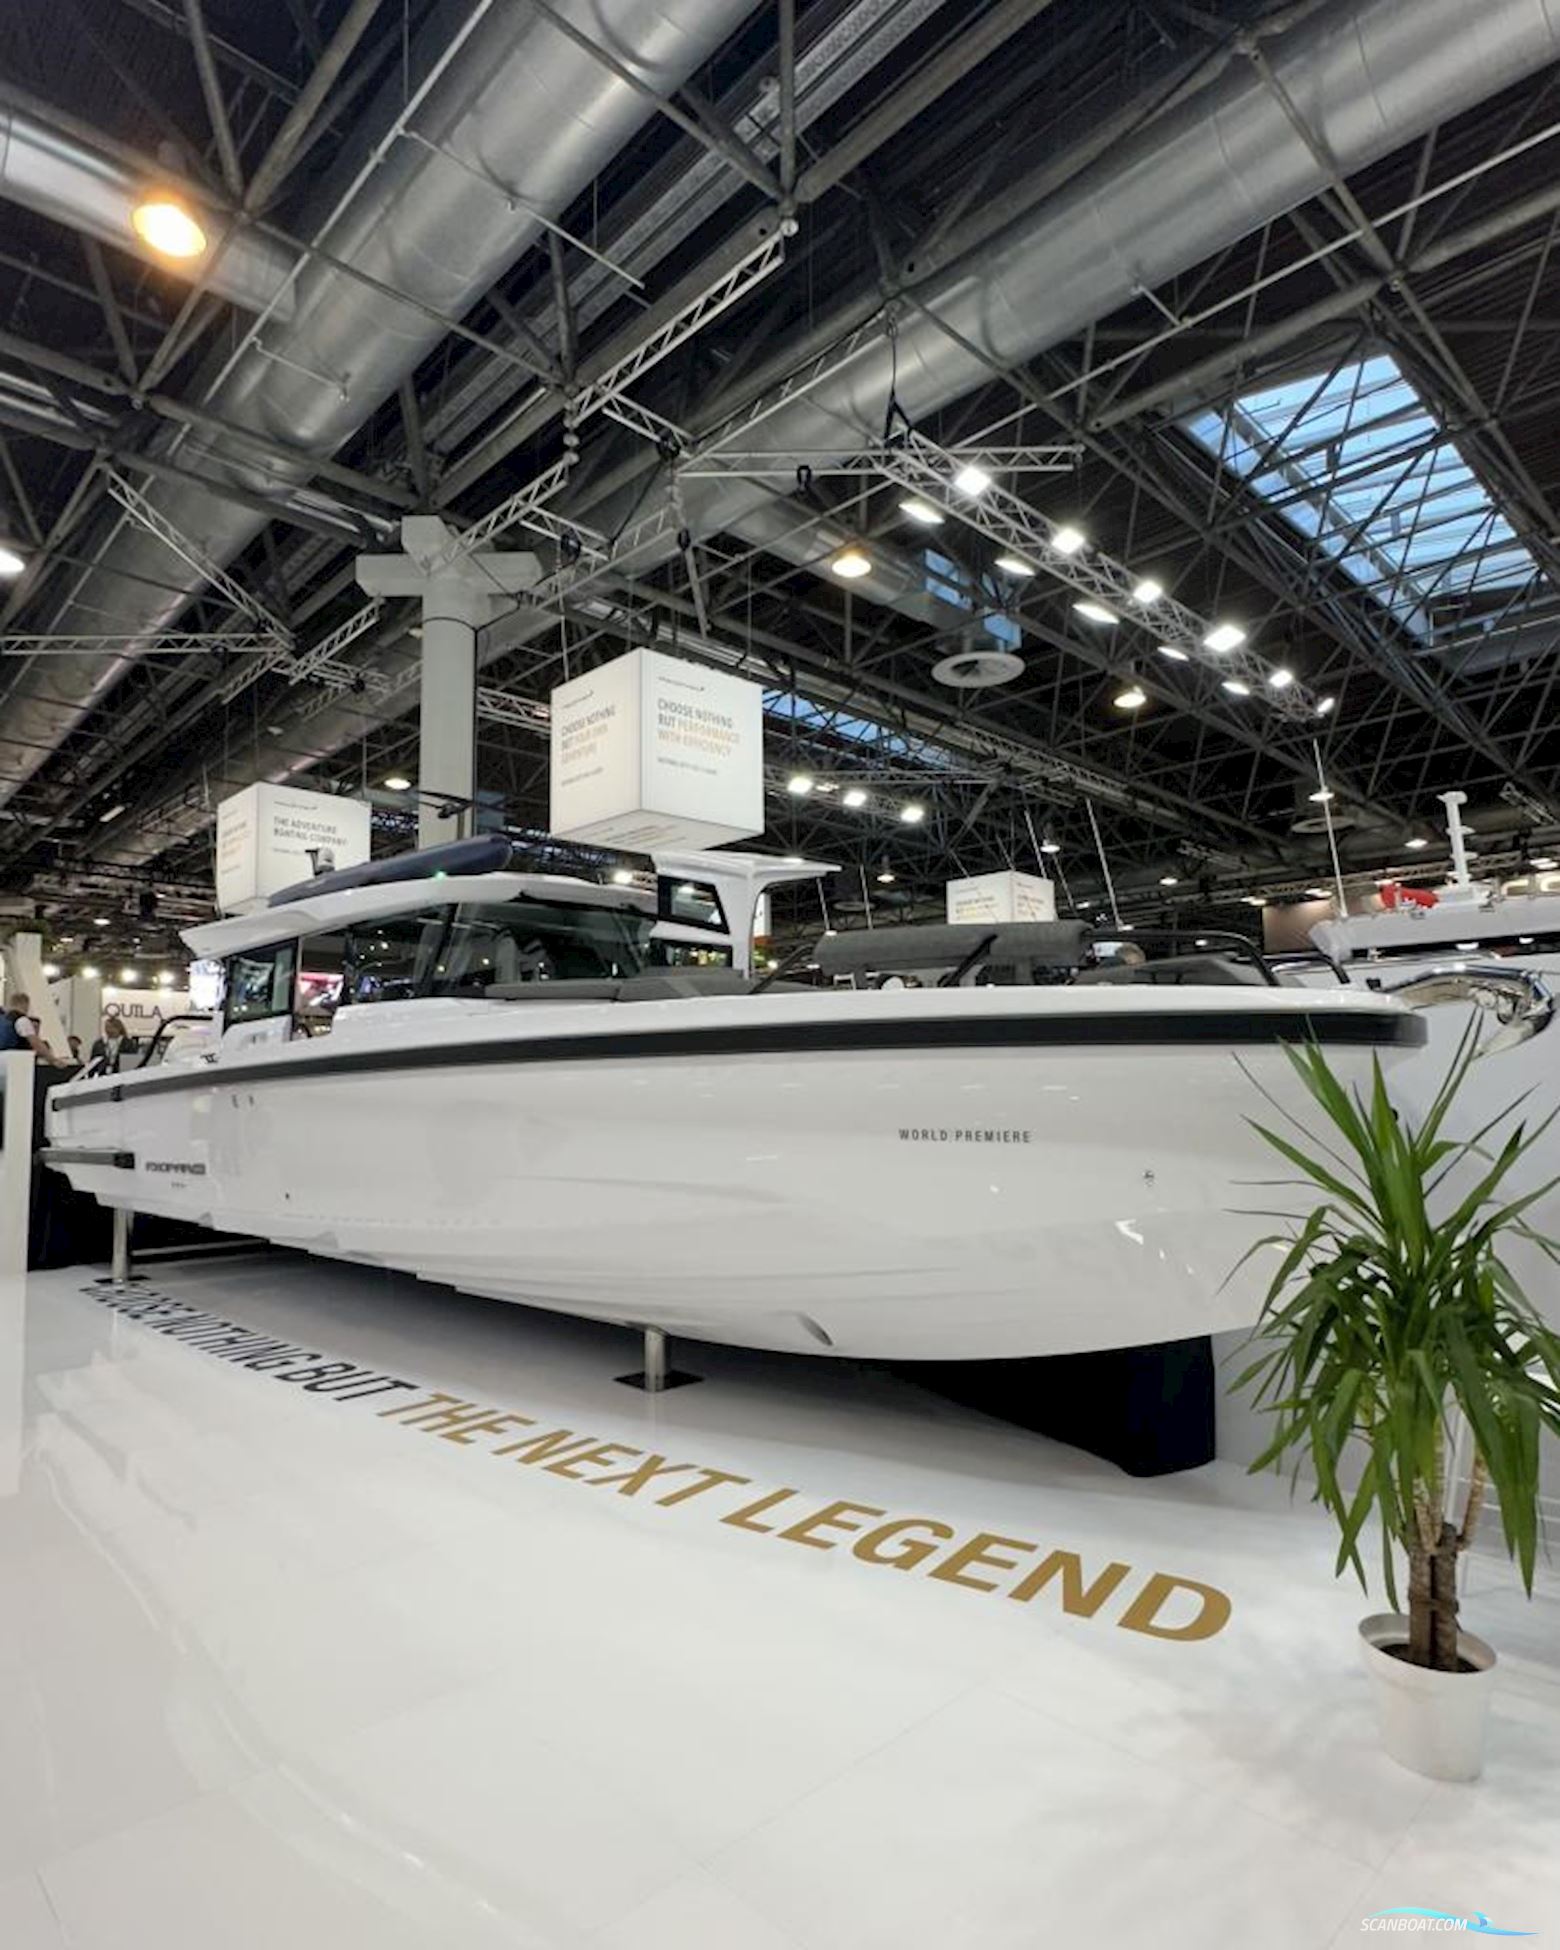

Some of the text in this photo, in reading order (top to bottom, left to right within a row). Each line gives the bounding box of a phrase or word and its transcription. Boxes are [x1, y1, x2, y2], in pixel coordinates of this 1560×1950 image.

[657, 697, 733, 728] CHOOSE NOTHING
[658, 713, 676, 728] BUT
[273, 816, 337, 834] THE ADVENTURE
[101, 1003, 163, 1020] QUILA
[898, 1129, 1031, 1143] WORLD PREMIERE
[143, 1313, 321, 1371] NOTHING
[273, 1362, 420, 1402] BUT
[376, 1393, 535, 1446] THE
[491, 1428, 751, 1508] NEXT
[719, 1488, 1233, 1643] LEGEND
